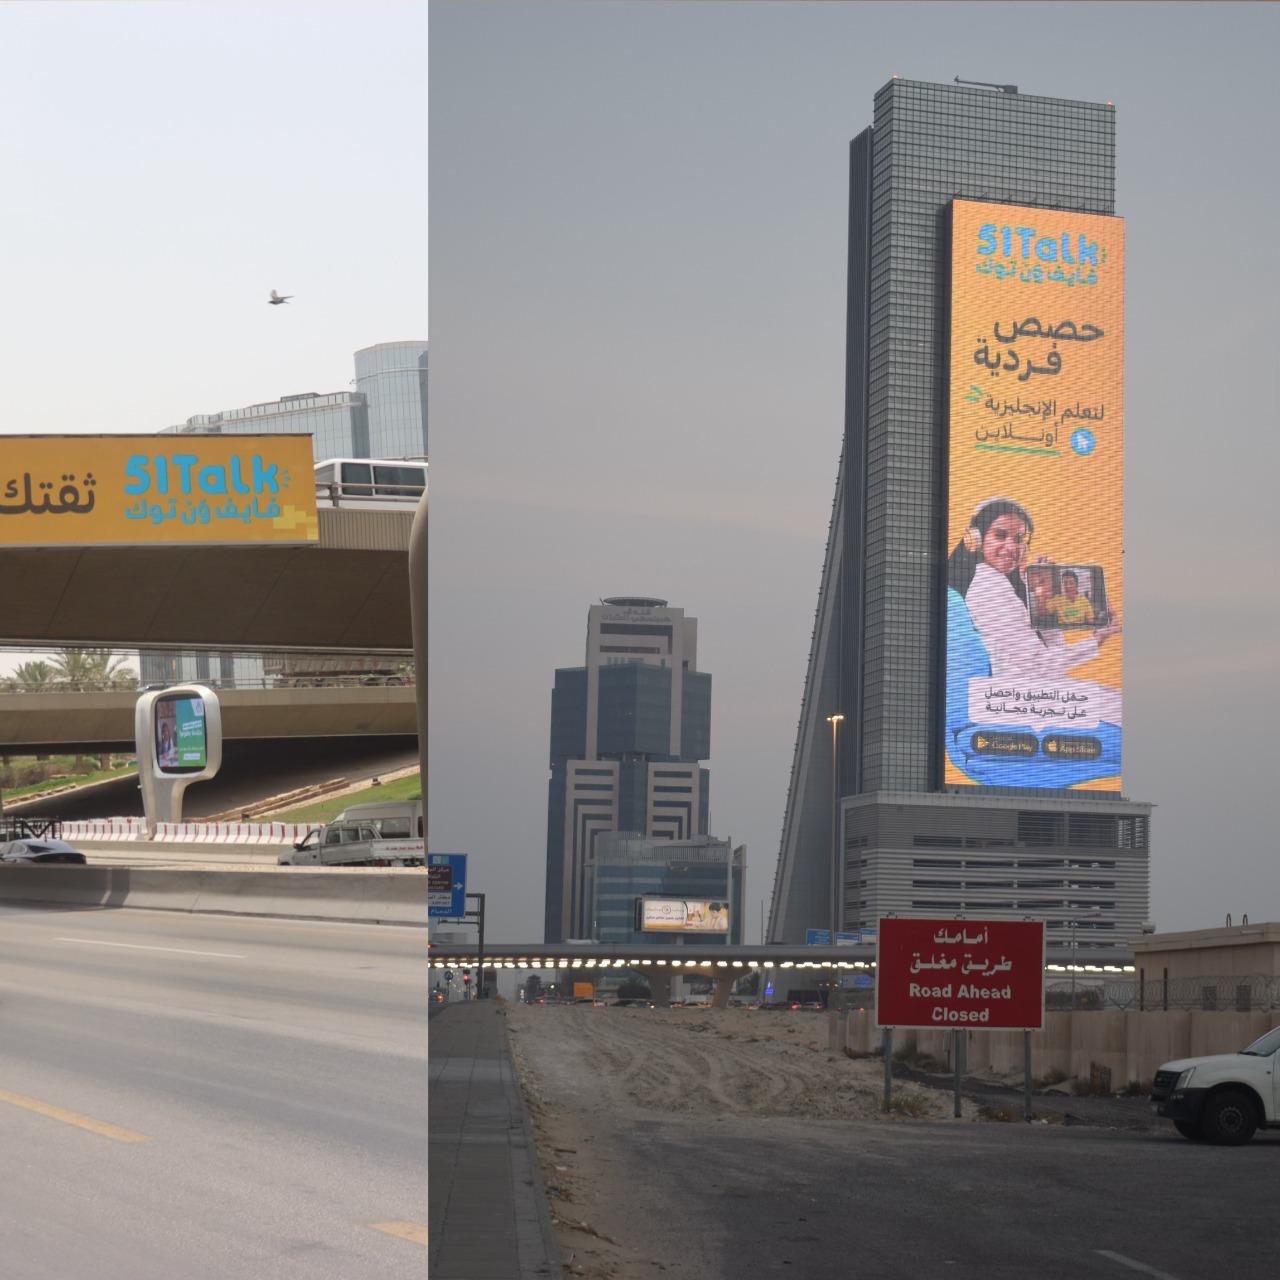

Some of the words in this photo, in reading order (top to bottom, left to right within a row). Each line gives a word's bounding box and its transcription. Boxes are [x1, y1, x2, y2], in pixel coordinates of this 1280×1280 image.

[976, 223, 1099, 267] 51Talk
[994, 316, 1104, 344] حصص
[974, 338, 1062, 381] فردية
[124, 454, 280, 495] 51Talk
[984, 686, 1020, 700] واحصل
[1023, 689, 1059, 702] التطبيق
[933, 925, 989, 944] أمامك
[910, 952, 957, 974] مغلق
[961, 953, 1012, 976] طريق
[909, 982, 952, 998] Road
[957, 984, 1011, 999] Ahead
[931, 1006, 989, 1022] Closed
